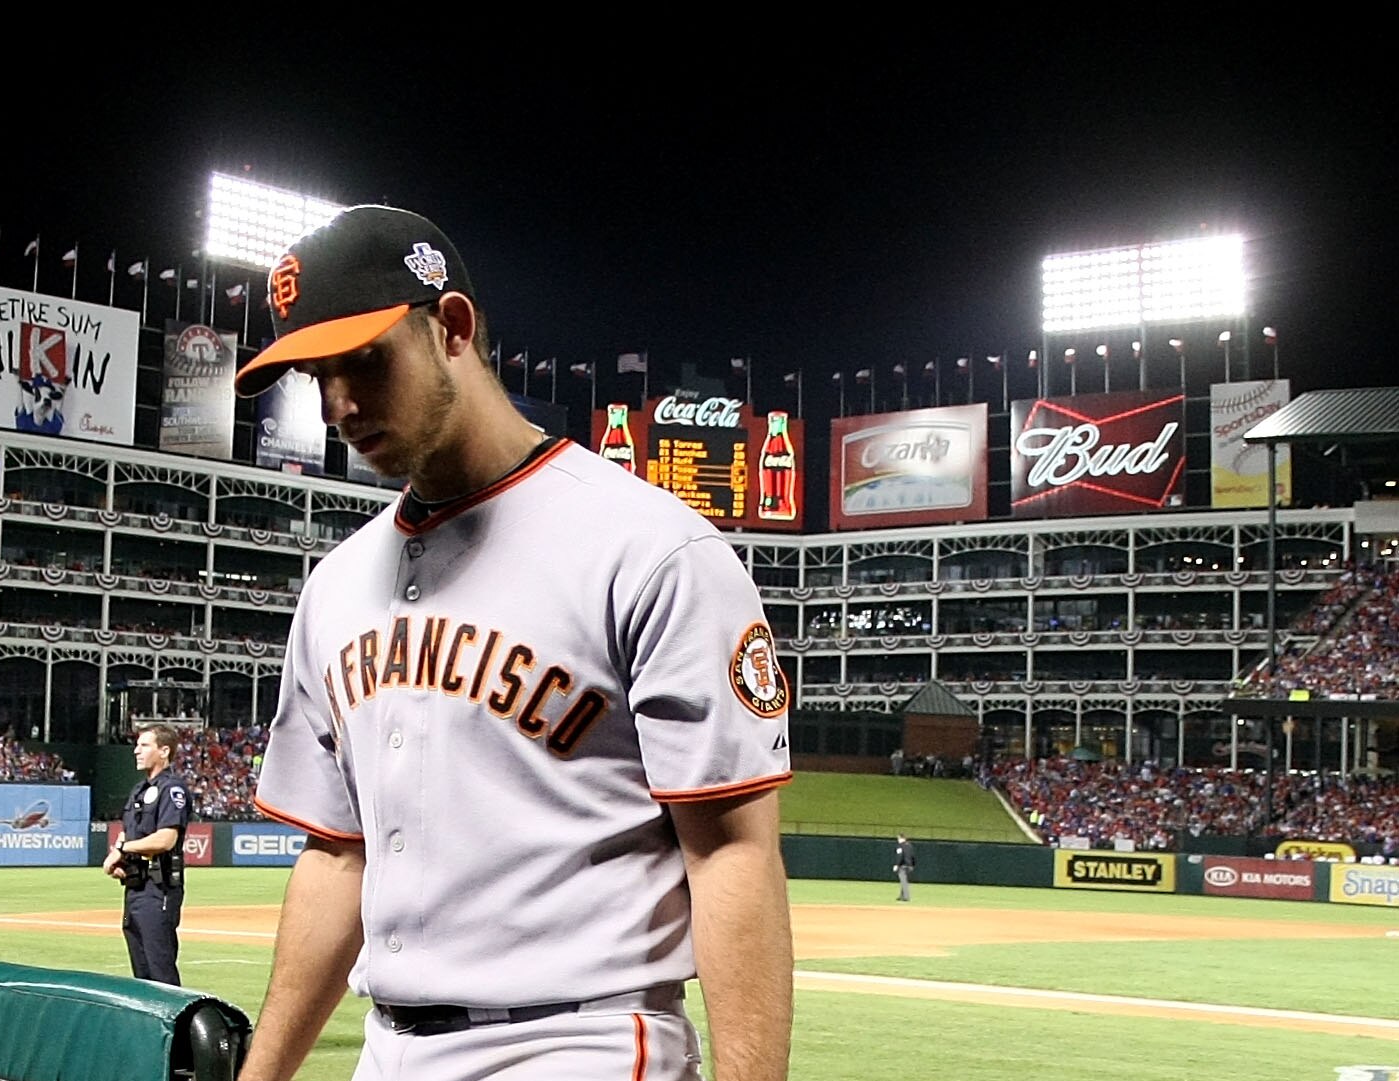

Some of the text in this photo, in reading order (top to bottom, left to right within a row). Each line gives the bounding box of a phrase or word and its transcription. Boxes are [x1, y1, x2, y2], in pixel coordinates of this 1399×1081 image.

[57, 306, 102, 343] SUM
[1016, 422, 1179, 487] Bud
[340, 615, 610, 761] FRANCISCO
[751, 688, 786, 712] GIANTS
[1073, 860, 1157, 879] STANLEY
[1210, 872, 1233, 882] KIA
[1241, 872, 1311, 887] KIA MOTORS
